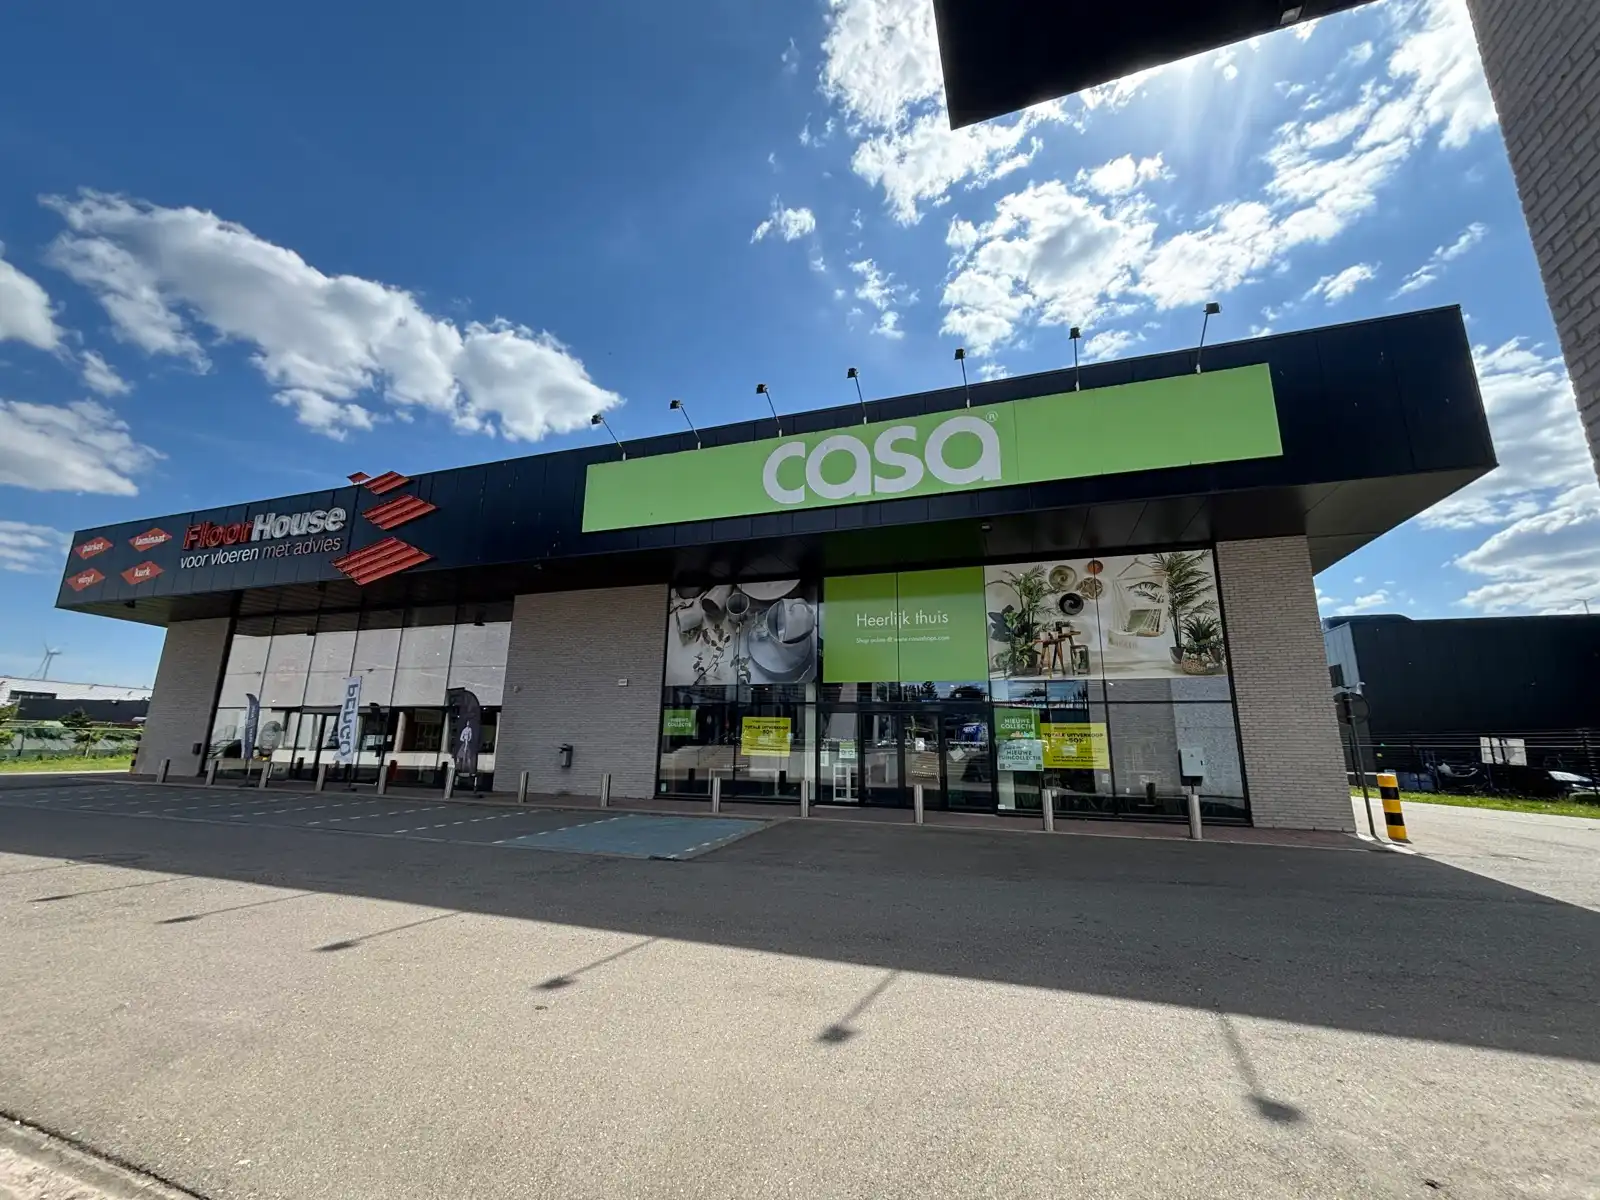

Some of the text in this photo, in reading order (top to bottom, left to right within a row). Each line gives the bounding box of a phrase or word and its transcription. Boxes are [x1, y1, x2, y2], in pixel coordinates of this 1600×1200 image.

[763, 416, 1001, 504] casa
[183, 507, 347, 549] FloorHouse
[82, 542, 104, 554] parket
[135, 534, 165, 546] laminaat
[180, 536, 341, 568] voor vloeren met advies
[78, 574, 95, 586] vinyl
[134, 567, 151, 578] kurk
[856, 609, 949, 629] Heerlijk thuis
